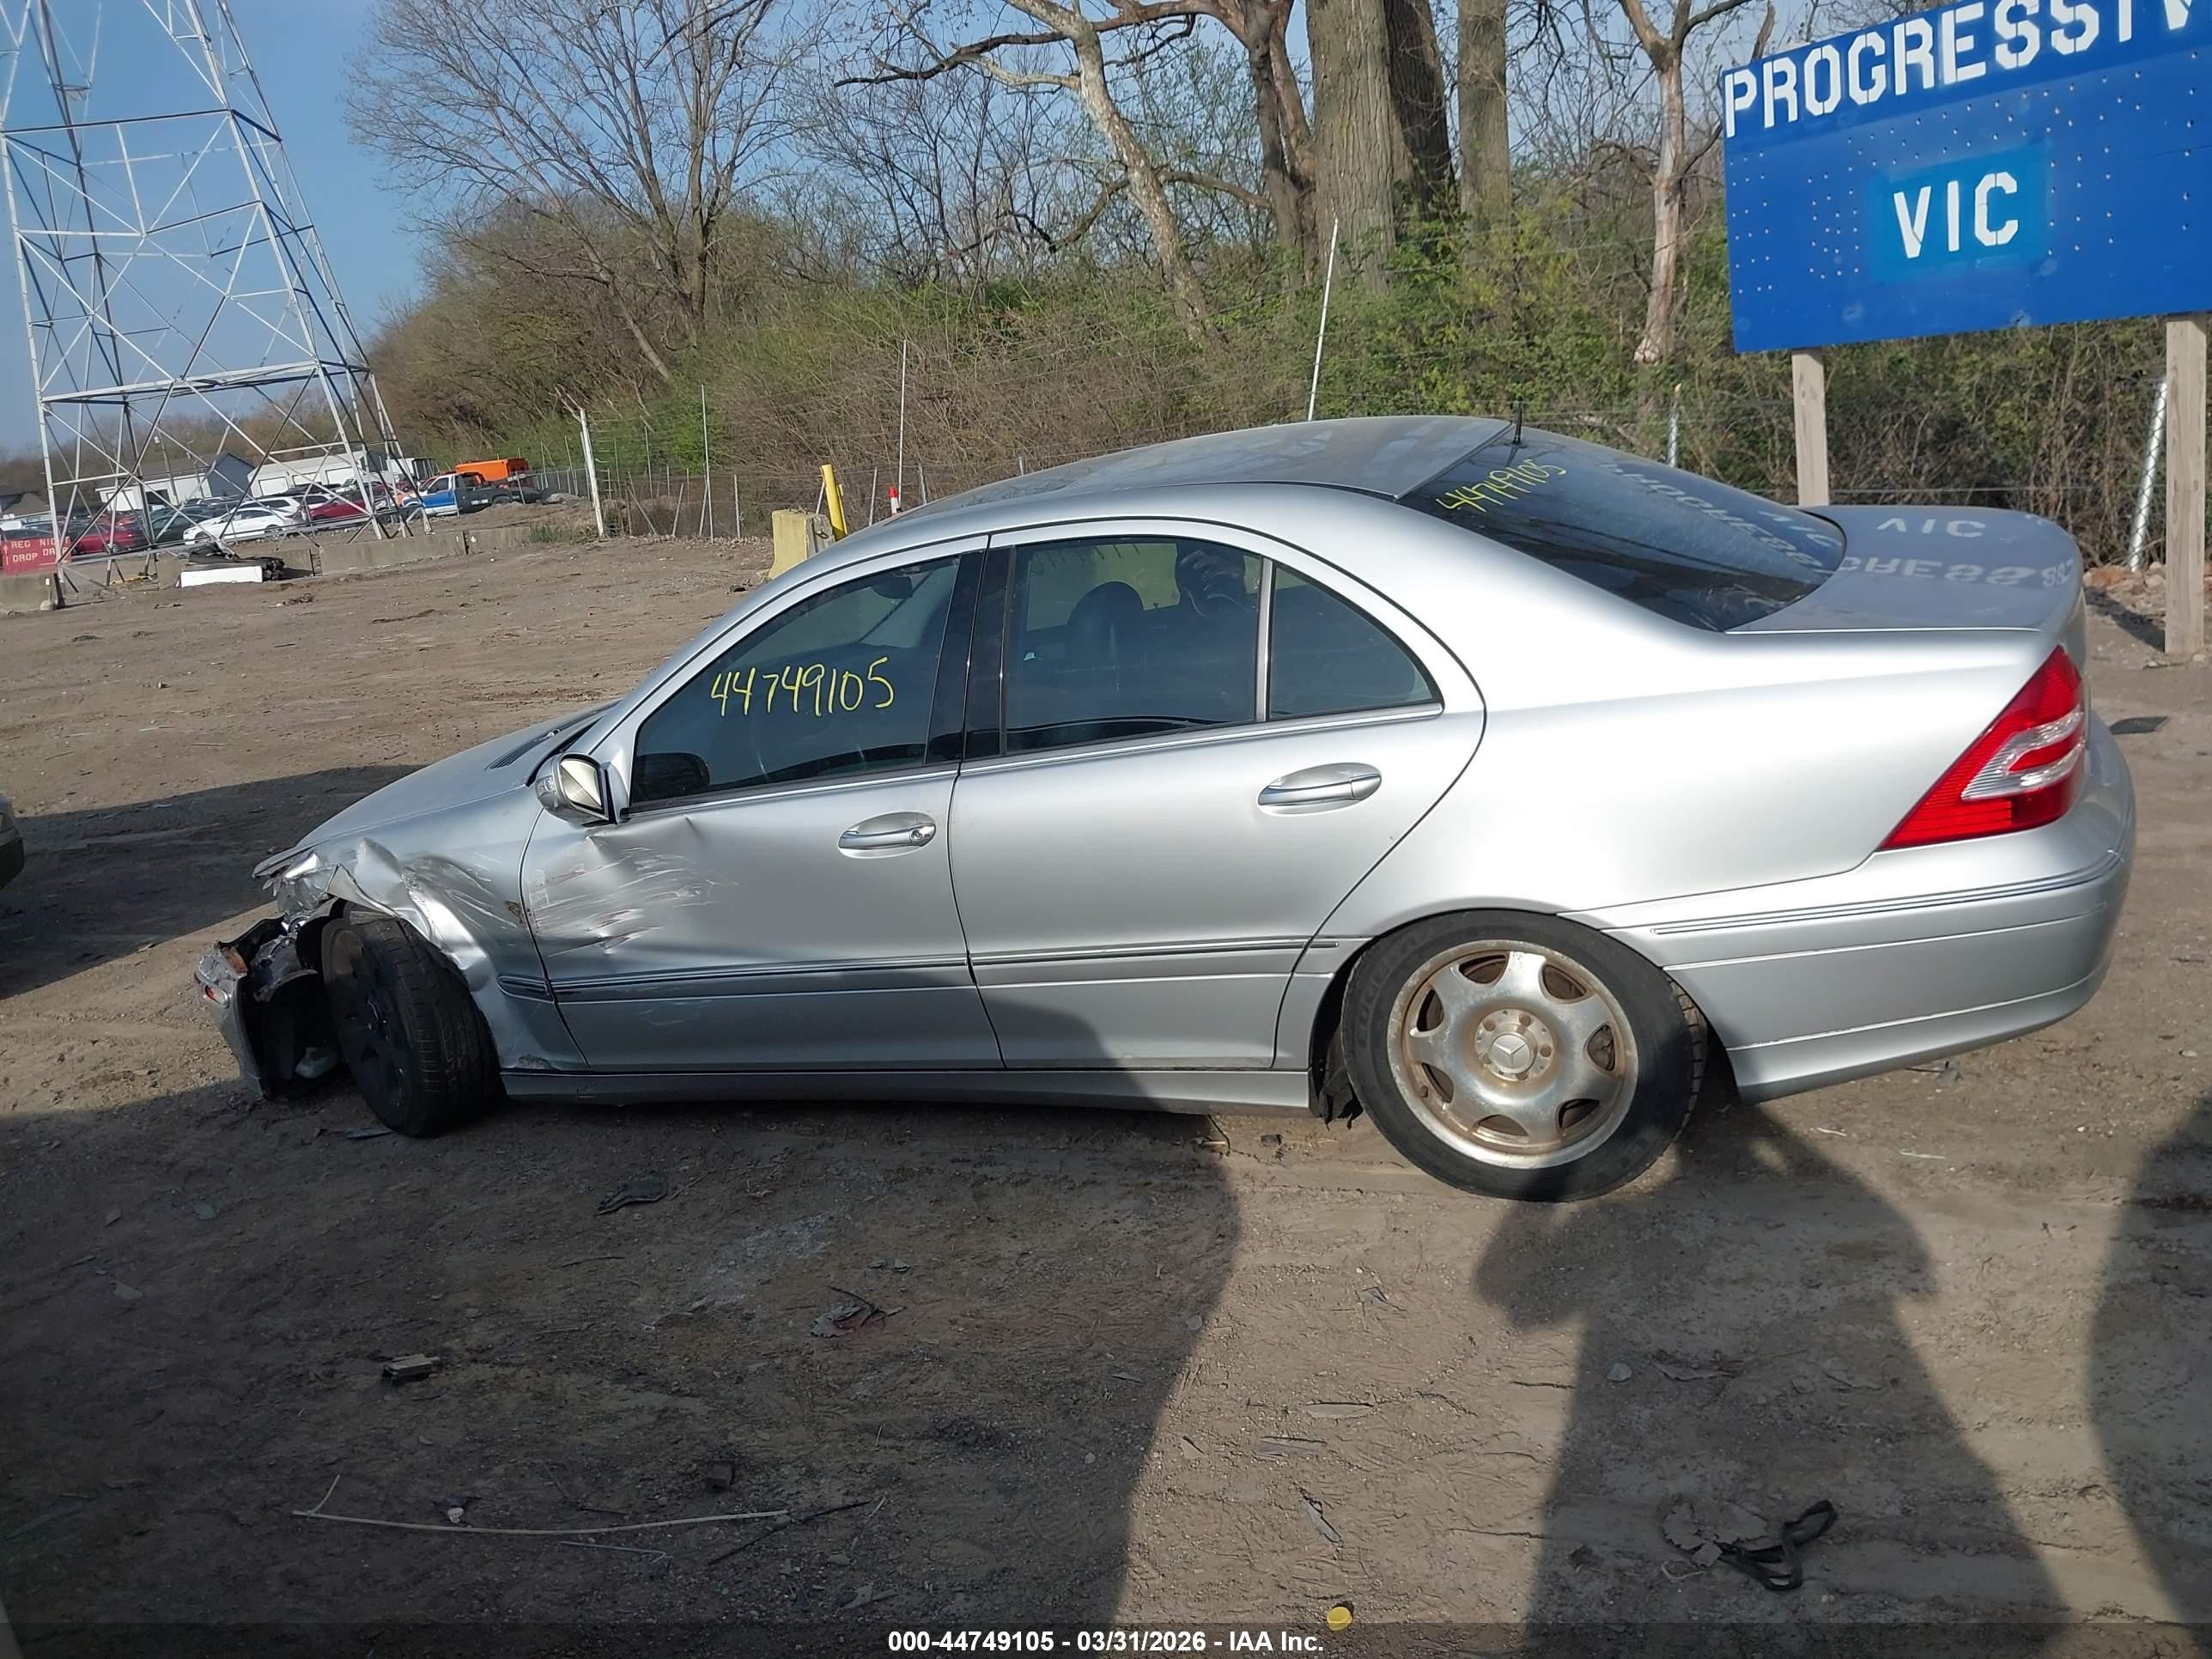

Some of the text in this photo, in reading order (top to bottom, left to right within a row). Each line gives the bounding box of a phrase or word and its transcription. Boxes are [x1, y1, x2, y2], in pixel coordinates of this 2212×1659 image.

[1893, 171, 2019, 258] VIC
[12, 552, 39, 562] DROP
[711, 657, 894, 716] 44749105
